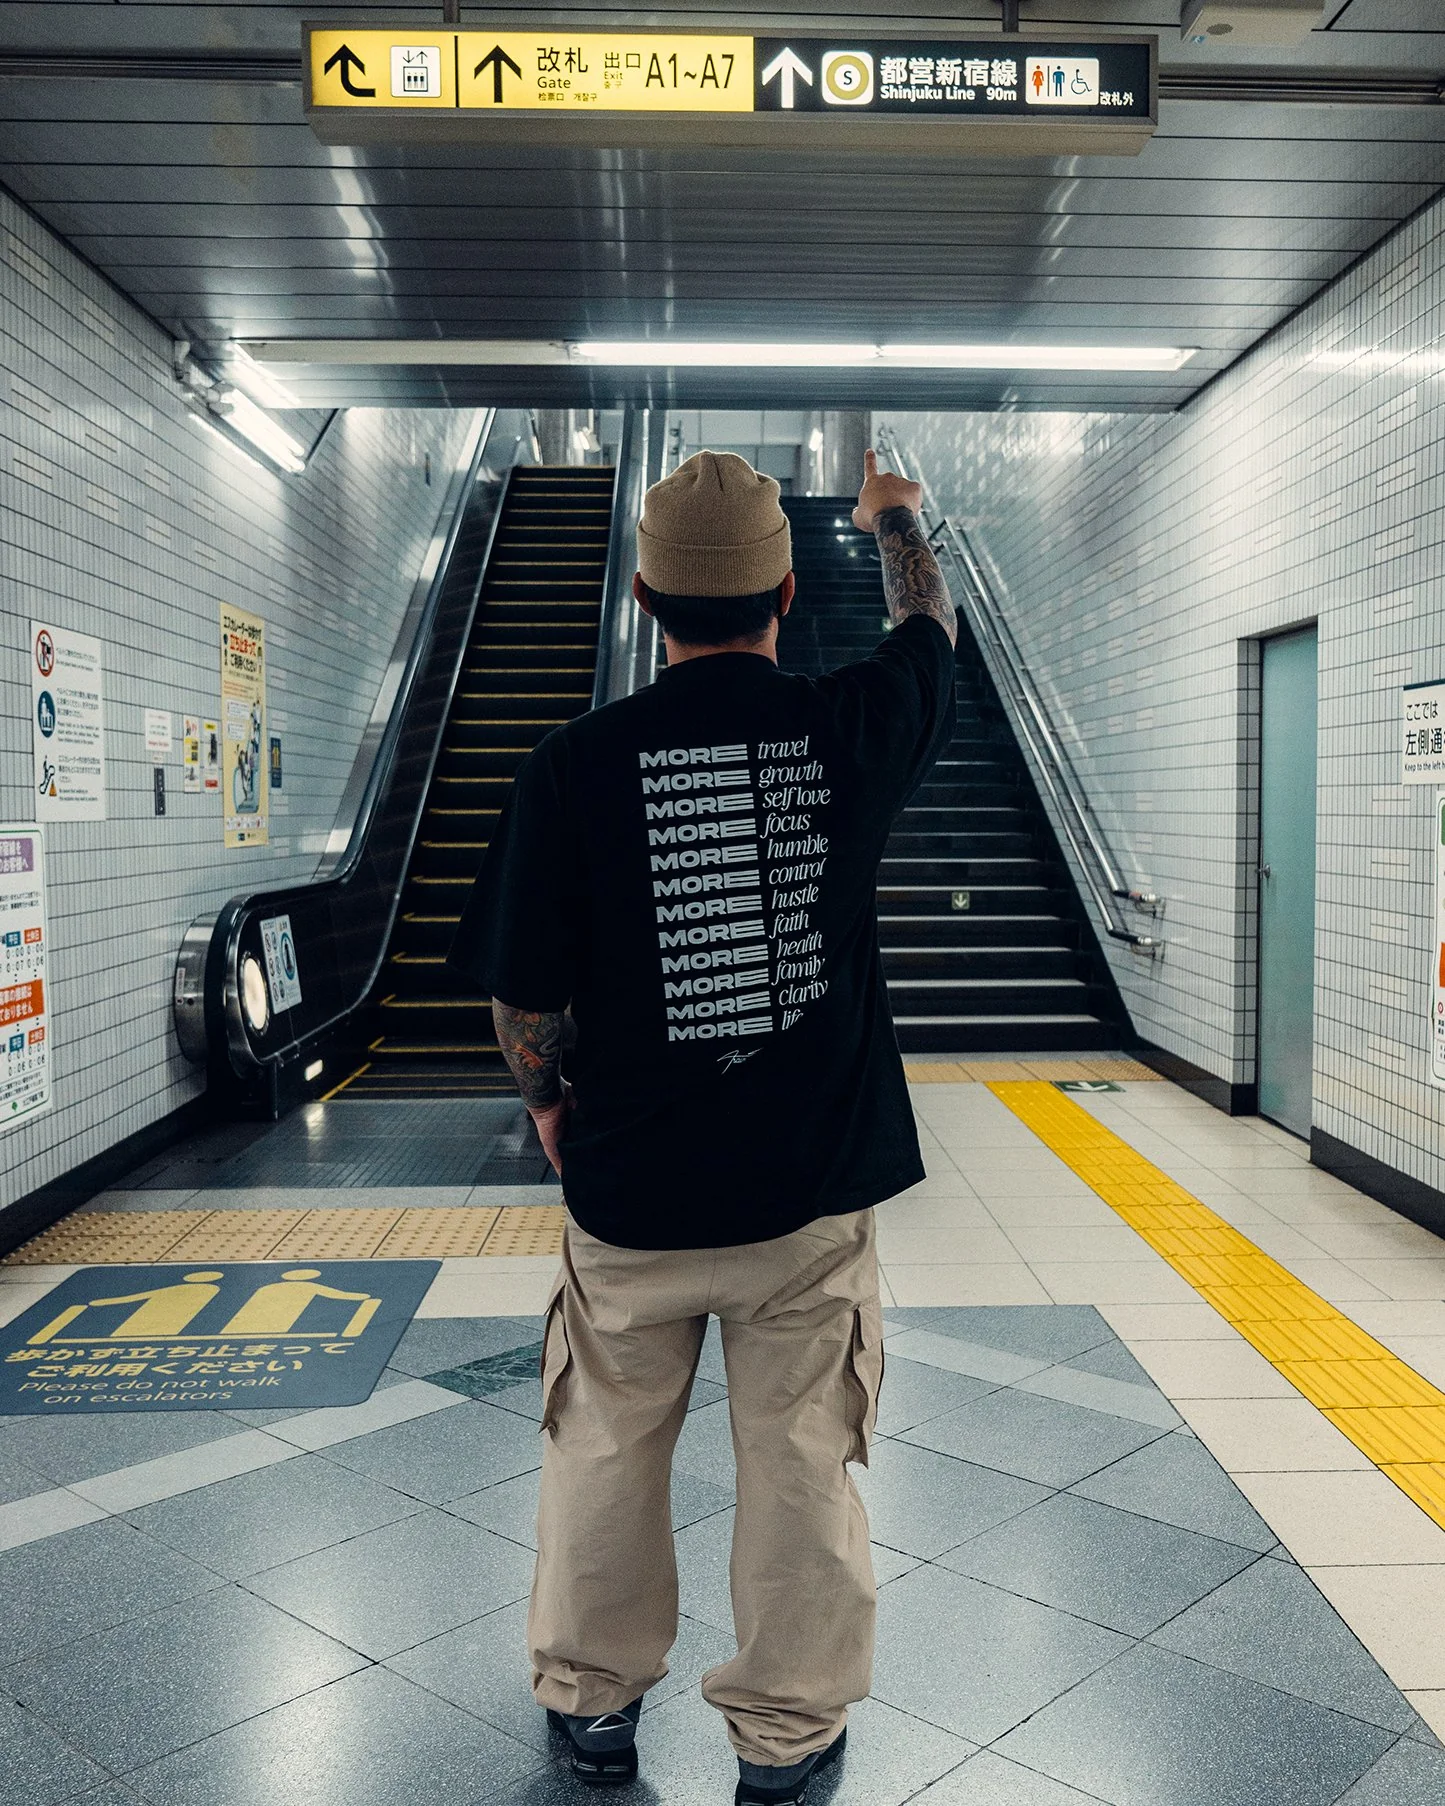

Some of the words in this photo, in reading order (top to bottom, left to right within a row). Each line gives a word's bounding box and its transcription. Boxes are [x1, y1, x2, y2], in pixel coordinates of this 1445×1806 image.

[536, 46, 588, 73] 改札
[604, 51, 641, 69] 出口
[880, 56, 1018, 86] 都営新宿線
[537, 76, 572, 89] Gate
[604, 71, 624, 80] Exit
[843, 70, 853, 86] S
[880, 85, 943, 103] Shinjuku
[945, 86, 976, 100] Line
[986, 87, 1017, 101] 90m
[1099, 91, 1135, 106] 改札外
[1406, 700, 1439, 721] ここでは
[639, 744, 748, 768] MORE
[757, 735, 809, 759] travel
[1405, 728, 1445, 756] 左側通
[642, 769, 751, 794] MORE
[758, 760, 823, 788] growth
[1404, 763, 1416, 773] Keep
[645, 793, 754, 820] MORE
[762, 786, 797, 811] self
[796, 786, 831, 806] love
[648, 818, 756, 846] MORE
[759, 812, 811, 839] focus
[650, 844, 758, 872] MORE
[767, 833, 829, 859] humble
[653, 869, 760, 897] MORE
[768, 857, 827, 885] control
[656, 895, 762, 923] MORE
[771, 883, 819, 909] hustle
[658, 919, 765, 948] MORE
[768, 909, 809, 939] faith
[661, 944, 769, 974] MORE
[776, 930, 823, 958] health
[664, 968, 769, 999] MORE
[770, 955, 826, 986] family
[666, 991, 771, 1020] MORE
[668, 1016, 773, 1042] MORE
[4, 1342, 355, 1363] 歩かず立ち止まって
[27, 1360, 303, 1378] ご利用ください
[18, 1380, 109, 1392] Please
[115, 1379, 153, 1390] do
[161, 1378, 211, 1389] not
[218, 1376, 282, 1387] walk
[43, 1394, 82, 1404] on
[90, 1391, 234, 1402] escalators
